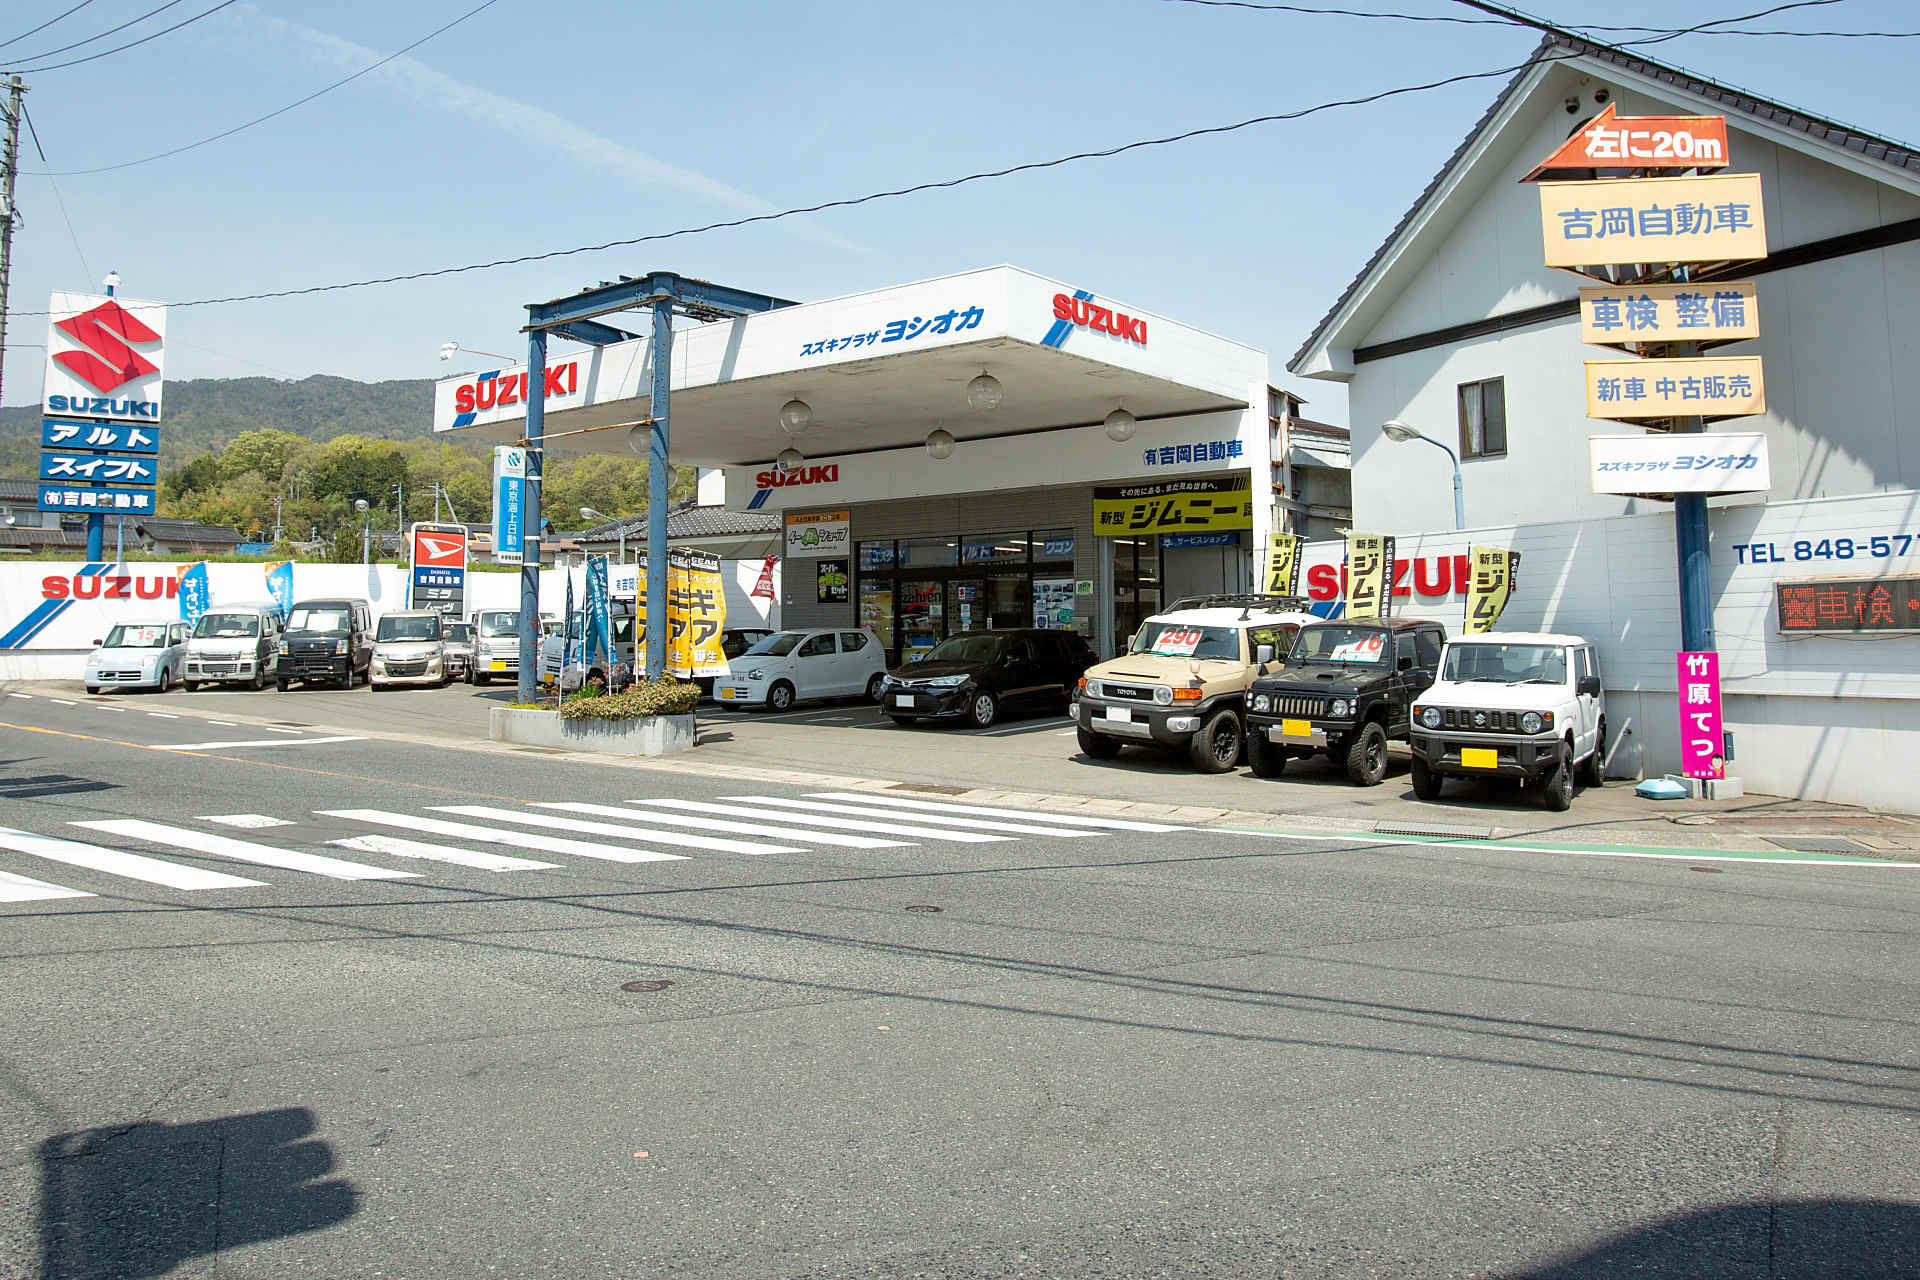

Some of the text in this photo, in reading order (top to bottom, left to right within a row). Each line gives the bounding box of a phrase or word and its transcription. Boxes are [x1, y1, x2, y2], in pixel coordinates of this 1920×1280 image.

[1584, 125, 1722, 159] 左に20m
[1557, 202, 1754, 240] 吉岡自動車
[1052, 293, 1148, 346] SUZUKI
[1591, 291, 1746, 331] 車検 整備
[800, 305, 985, 357] スズキプラザ ヨシオカ
[455, 361, 578, 414] SUZKI
[1597, 374, 1753, 402] 新車 中古販売
[48, 394, 159, 417] SUZUKI
[49, 424, 153, 448] アルト
[47, 457, 151, 479] スイフト
[756, 463, 839, 489] SUZUKI
[1597, 454, 1759, 473] スズキプラザ ヨシオカ
[1100, 511, 1126, 526] 新型
[1129, 499, 1238, 530] ジムニー
[1356, 538, 1378, 549] 新型
[1732, 533, 1920, 565] TEL 848-57
[1479, 553, 1504, 566] 新型
[426, 588, 453, 599] ミラ
[1159, 627, 1202, 646] 290
[1354, 633, 1384, 652] 76
[1116, 688, 1138, 696] TOYOTA
[1685, 654, 1715, 758] 竹原てつ
